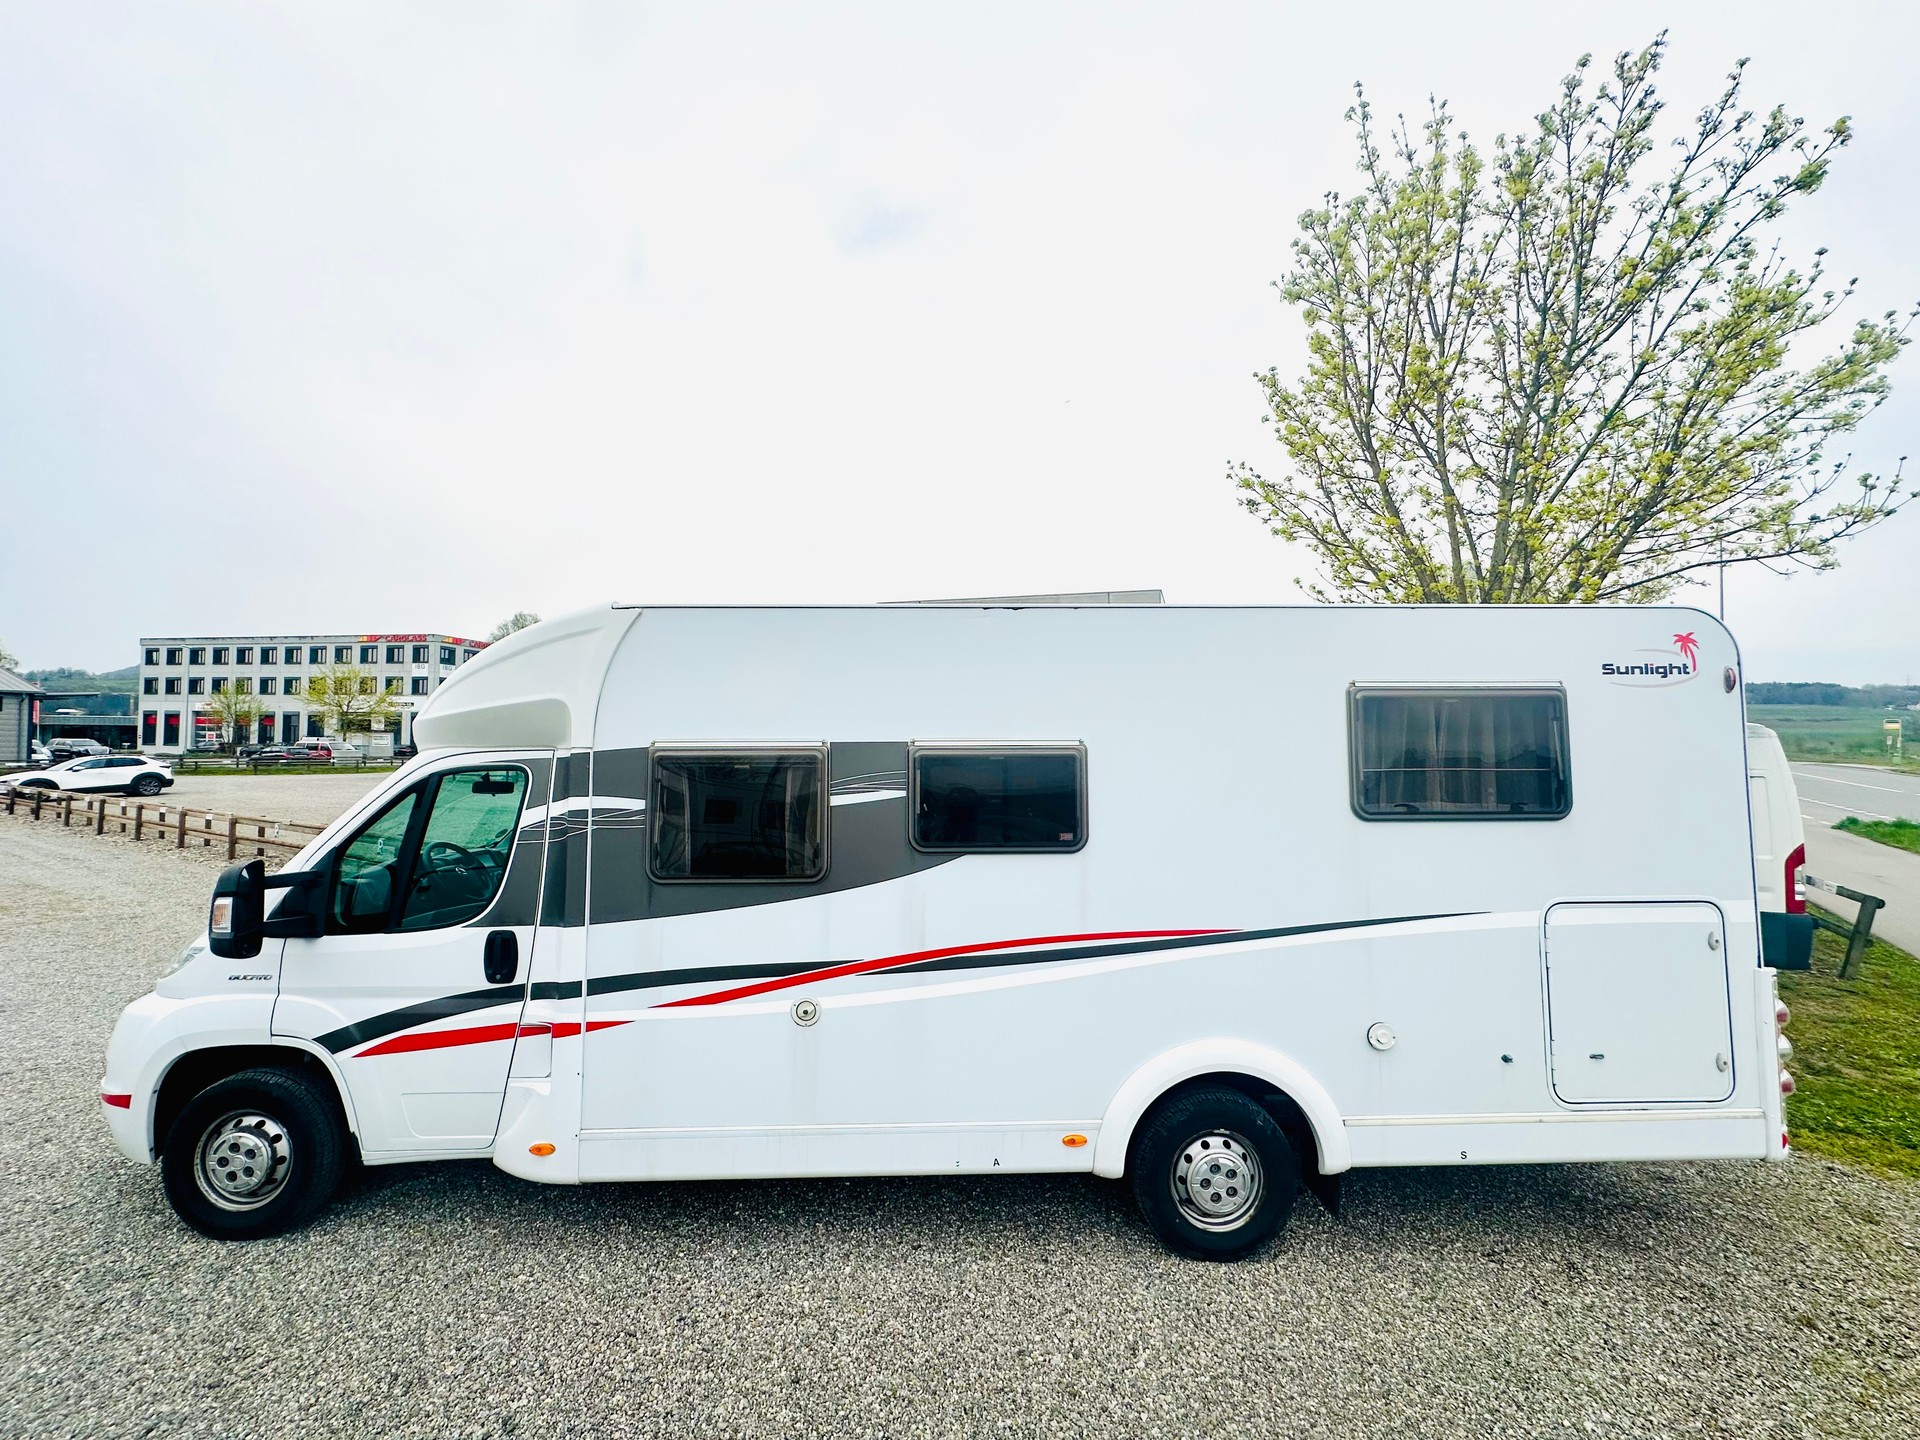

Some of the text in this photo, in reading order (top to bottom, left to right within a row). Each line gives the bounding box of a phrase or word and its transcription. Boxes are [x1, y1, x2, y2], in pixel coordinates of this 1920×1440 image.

[1601, 663, 1690, 678] Sunlight
[1460, 1150, 1468, 1160] S
[993, 1158, 1000, 1166] A
